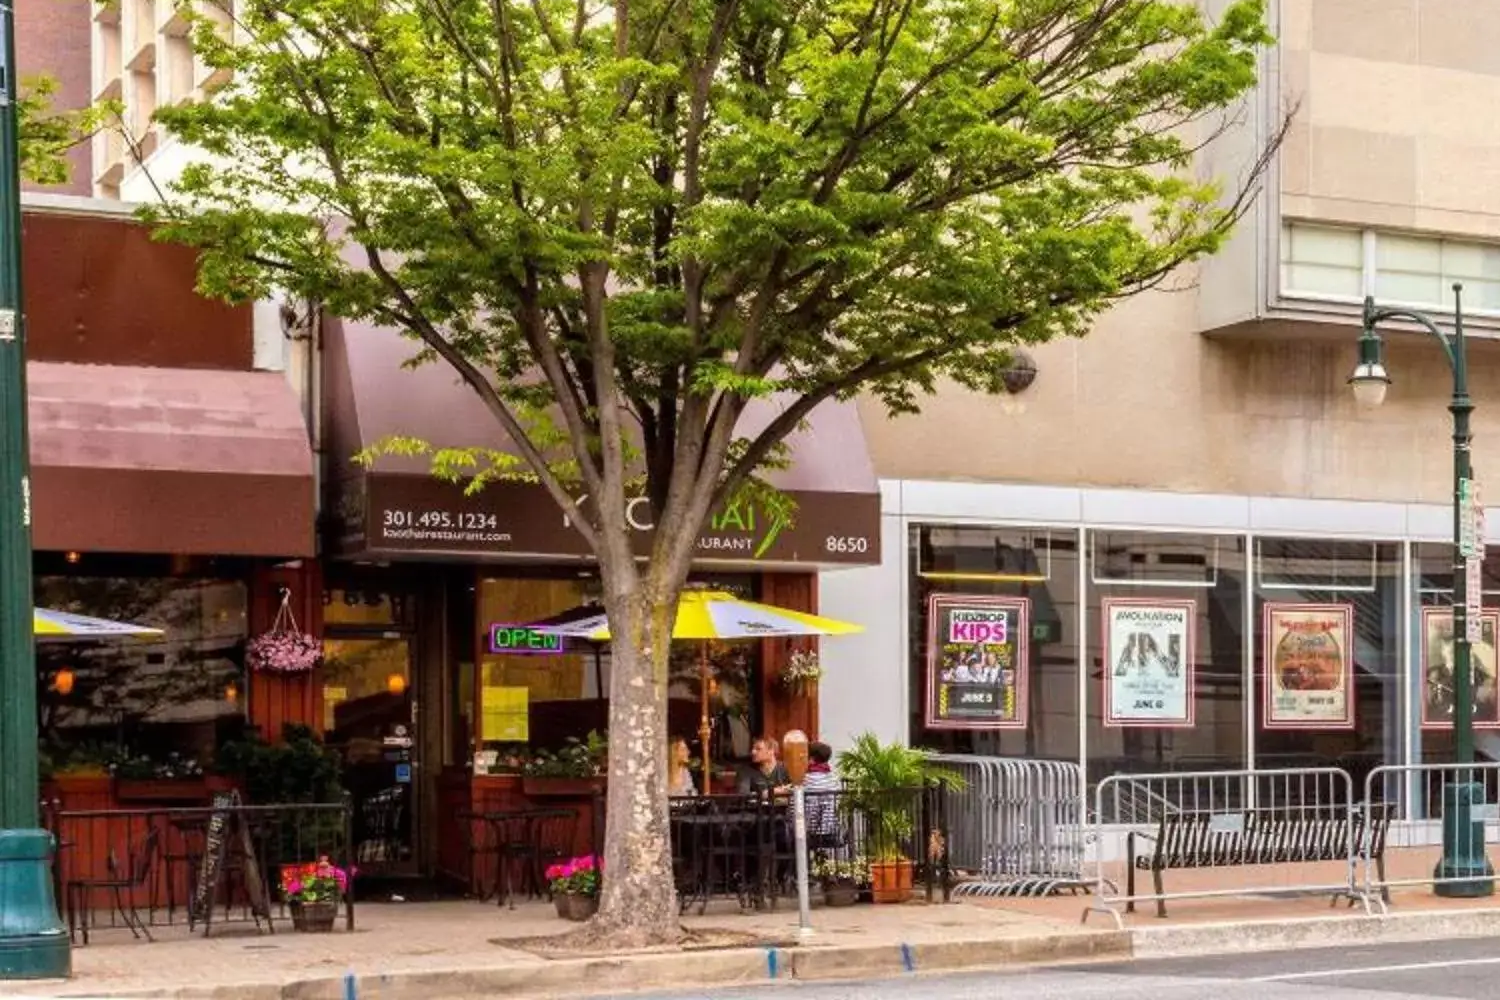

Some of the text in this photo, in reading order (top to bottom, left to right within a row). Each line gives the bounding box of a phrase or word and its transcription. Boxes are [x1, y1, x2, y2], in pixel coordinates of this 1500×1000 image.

[383, 510, 498, 529] 301.495.1234
[383, 527, 512, 541] kaothairestaurant.com
[826, 536, 868, 553] 8650
[496, 628, 558, 649] OPEN
[953, 623, 1005, 641] KIDS
